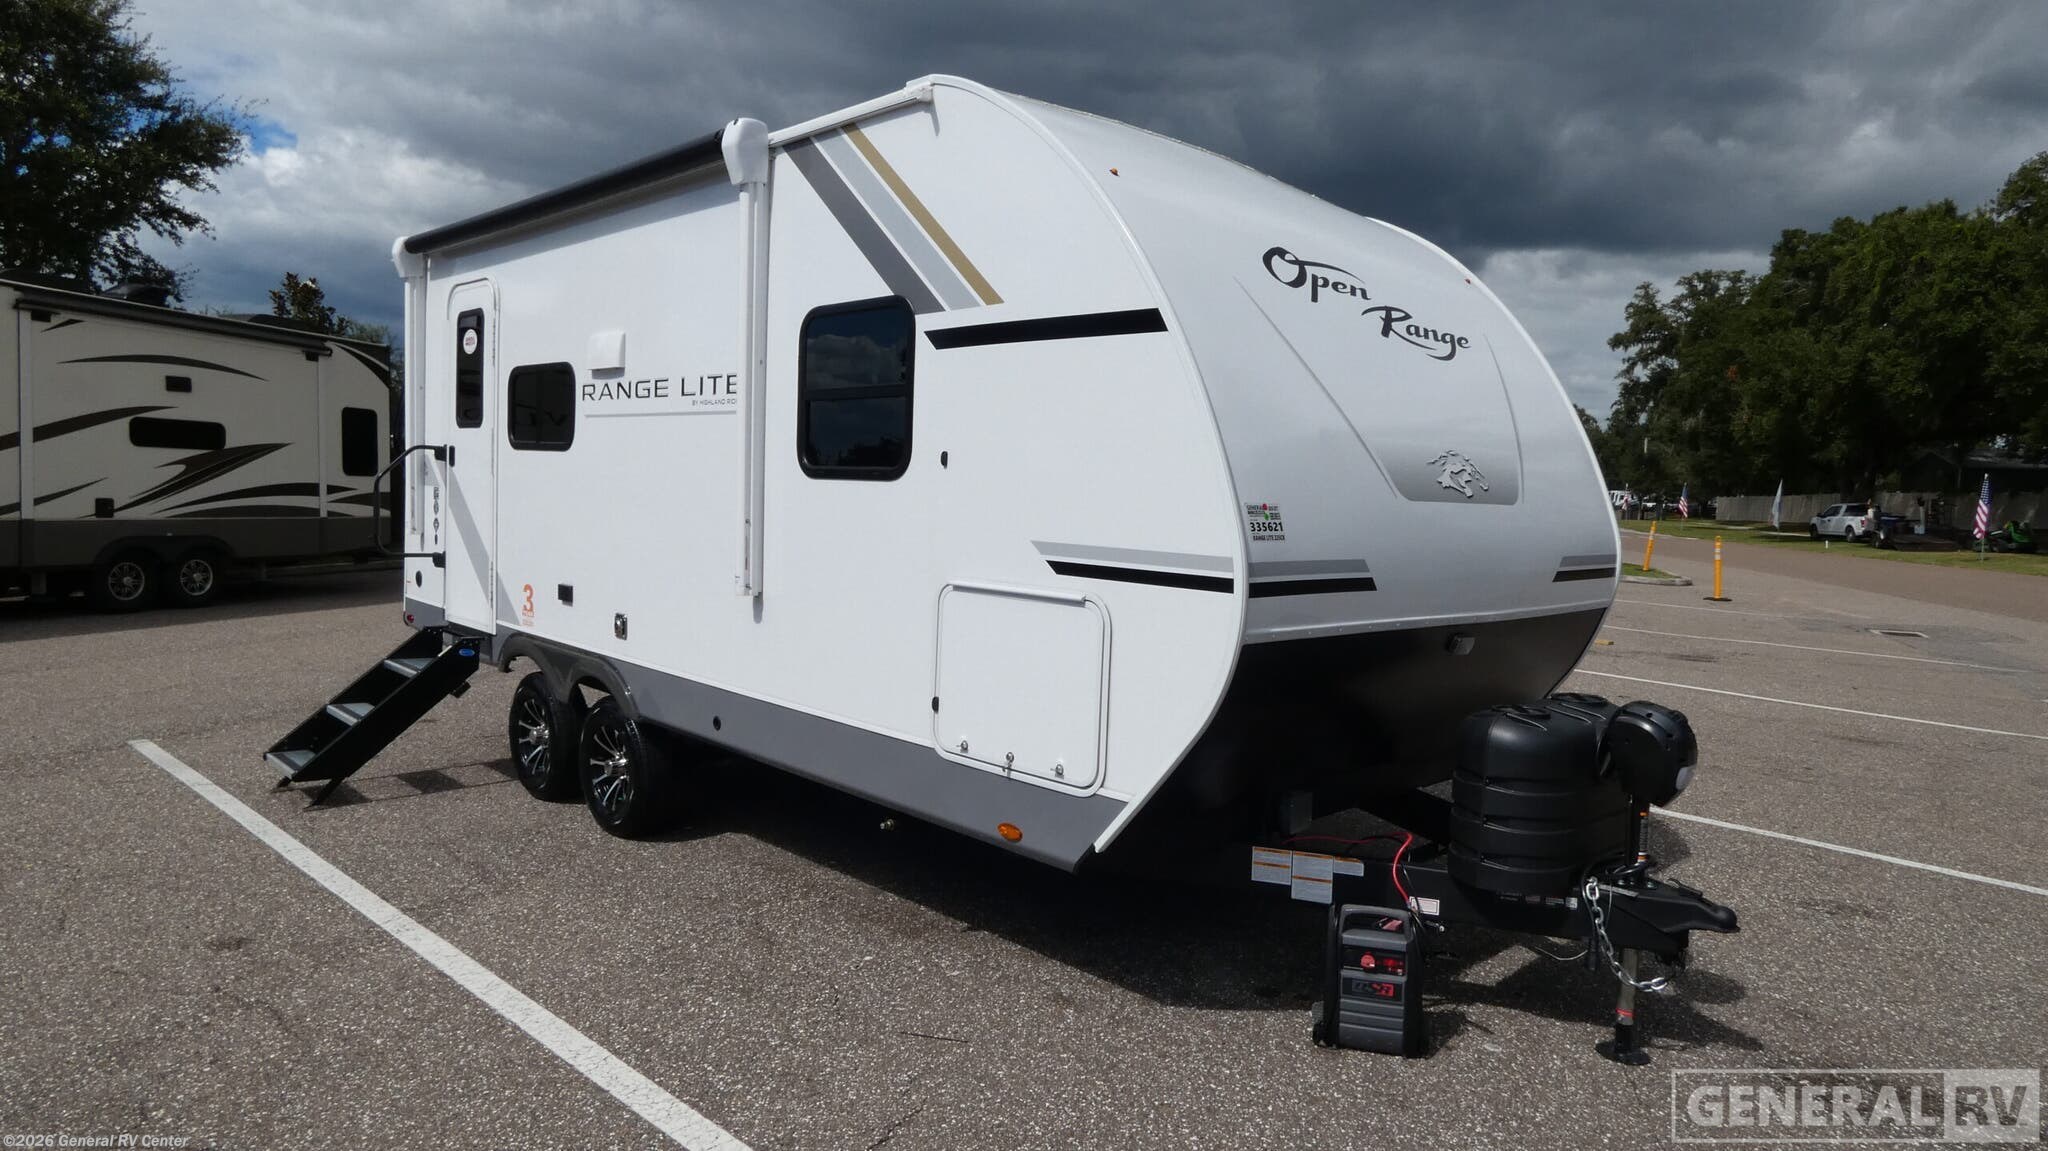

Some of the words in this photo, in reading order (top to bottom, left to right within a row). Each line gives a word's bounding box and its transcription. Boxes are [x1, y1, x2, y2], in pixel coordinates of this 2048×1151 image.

[1262, 246, 1372, 303] Open
[1361, 305, 1471, 361] Range
[582, 378, 669, 401] RANGE
[681, 374, 737, 397] LITE
[1250, 521, 1283, 532] 335621
[523, 583, 534, 611] 3
